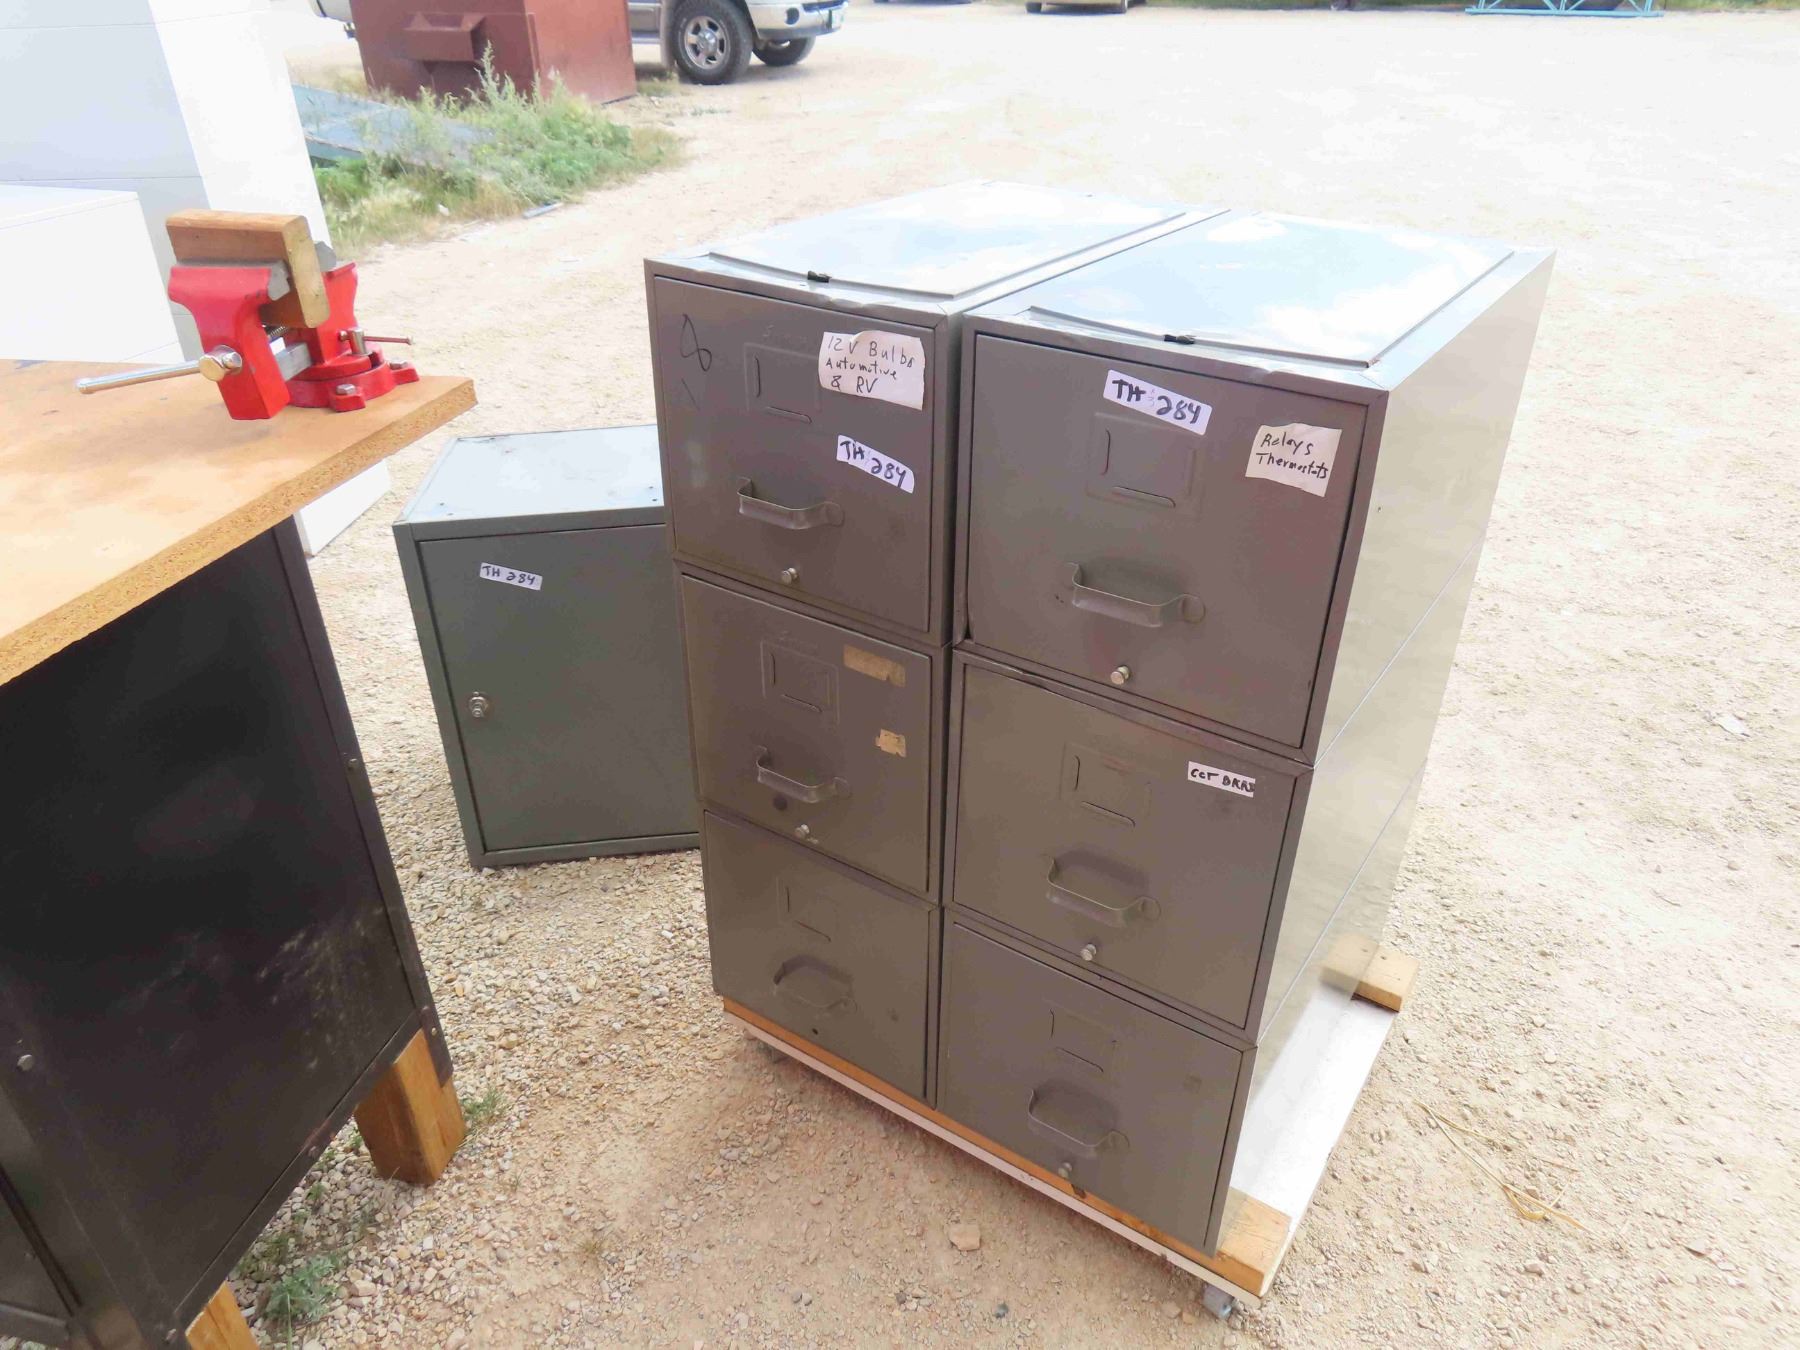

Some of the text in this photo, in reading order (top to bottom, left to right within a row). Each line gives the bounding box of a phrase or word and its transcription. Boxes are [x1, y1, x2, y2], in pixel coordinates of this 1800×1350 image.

[869, 340, 916, 368] Bulbs
[826, 357, 897, 380] Automotive
[856, 376, 878, 393] RV
[1112, 379, 1146, 402] TH
[1156, 395, 1202, 424] 284
[1261, 431, 1314, 455] Relays
[840, 440, 906, 487] TH 284
[1255, 452, 1329, 479] Thermostats
[482, 565, 536, 585] TH 284
